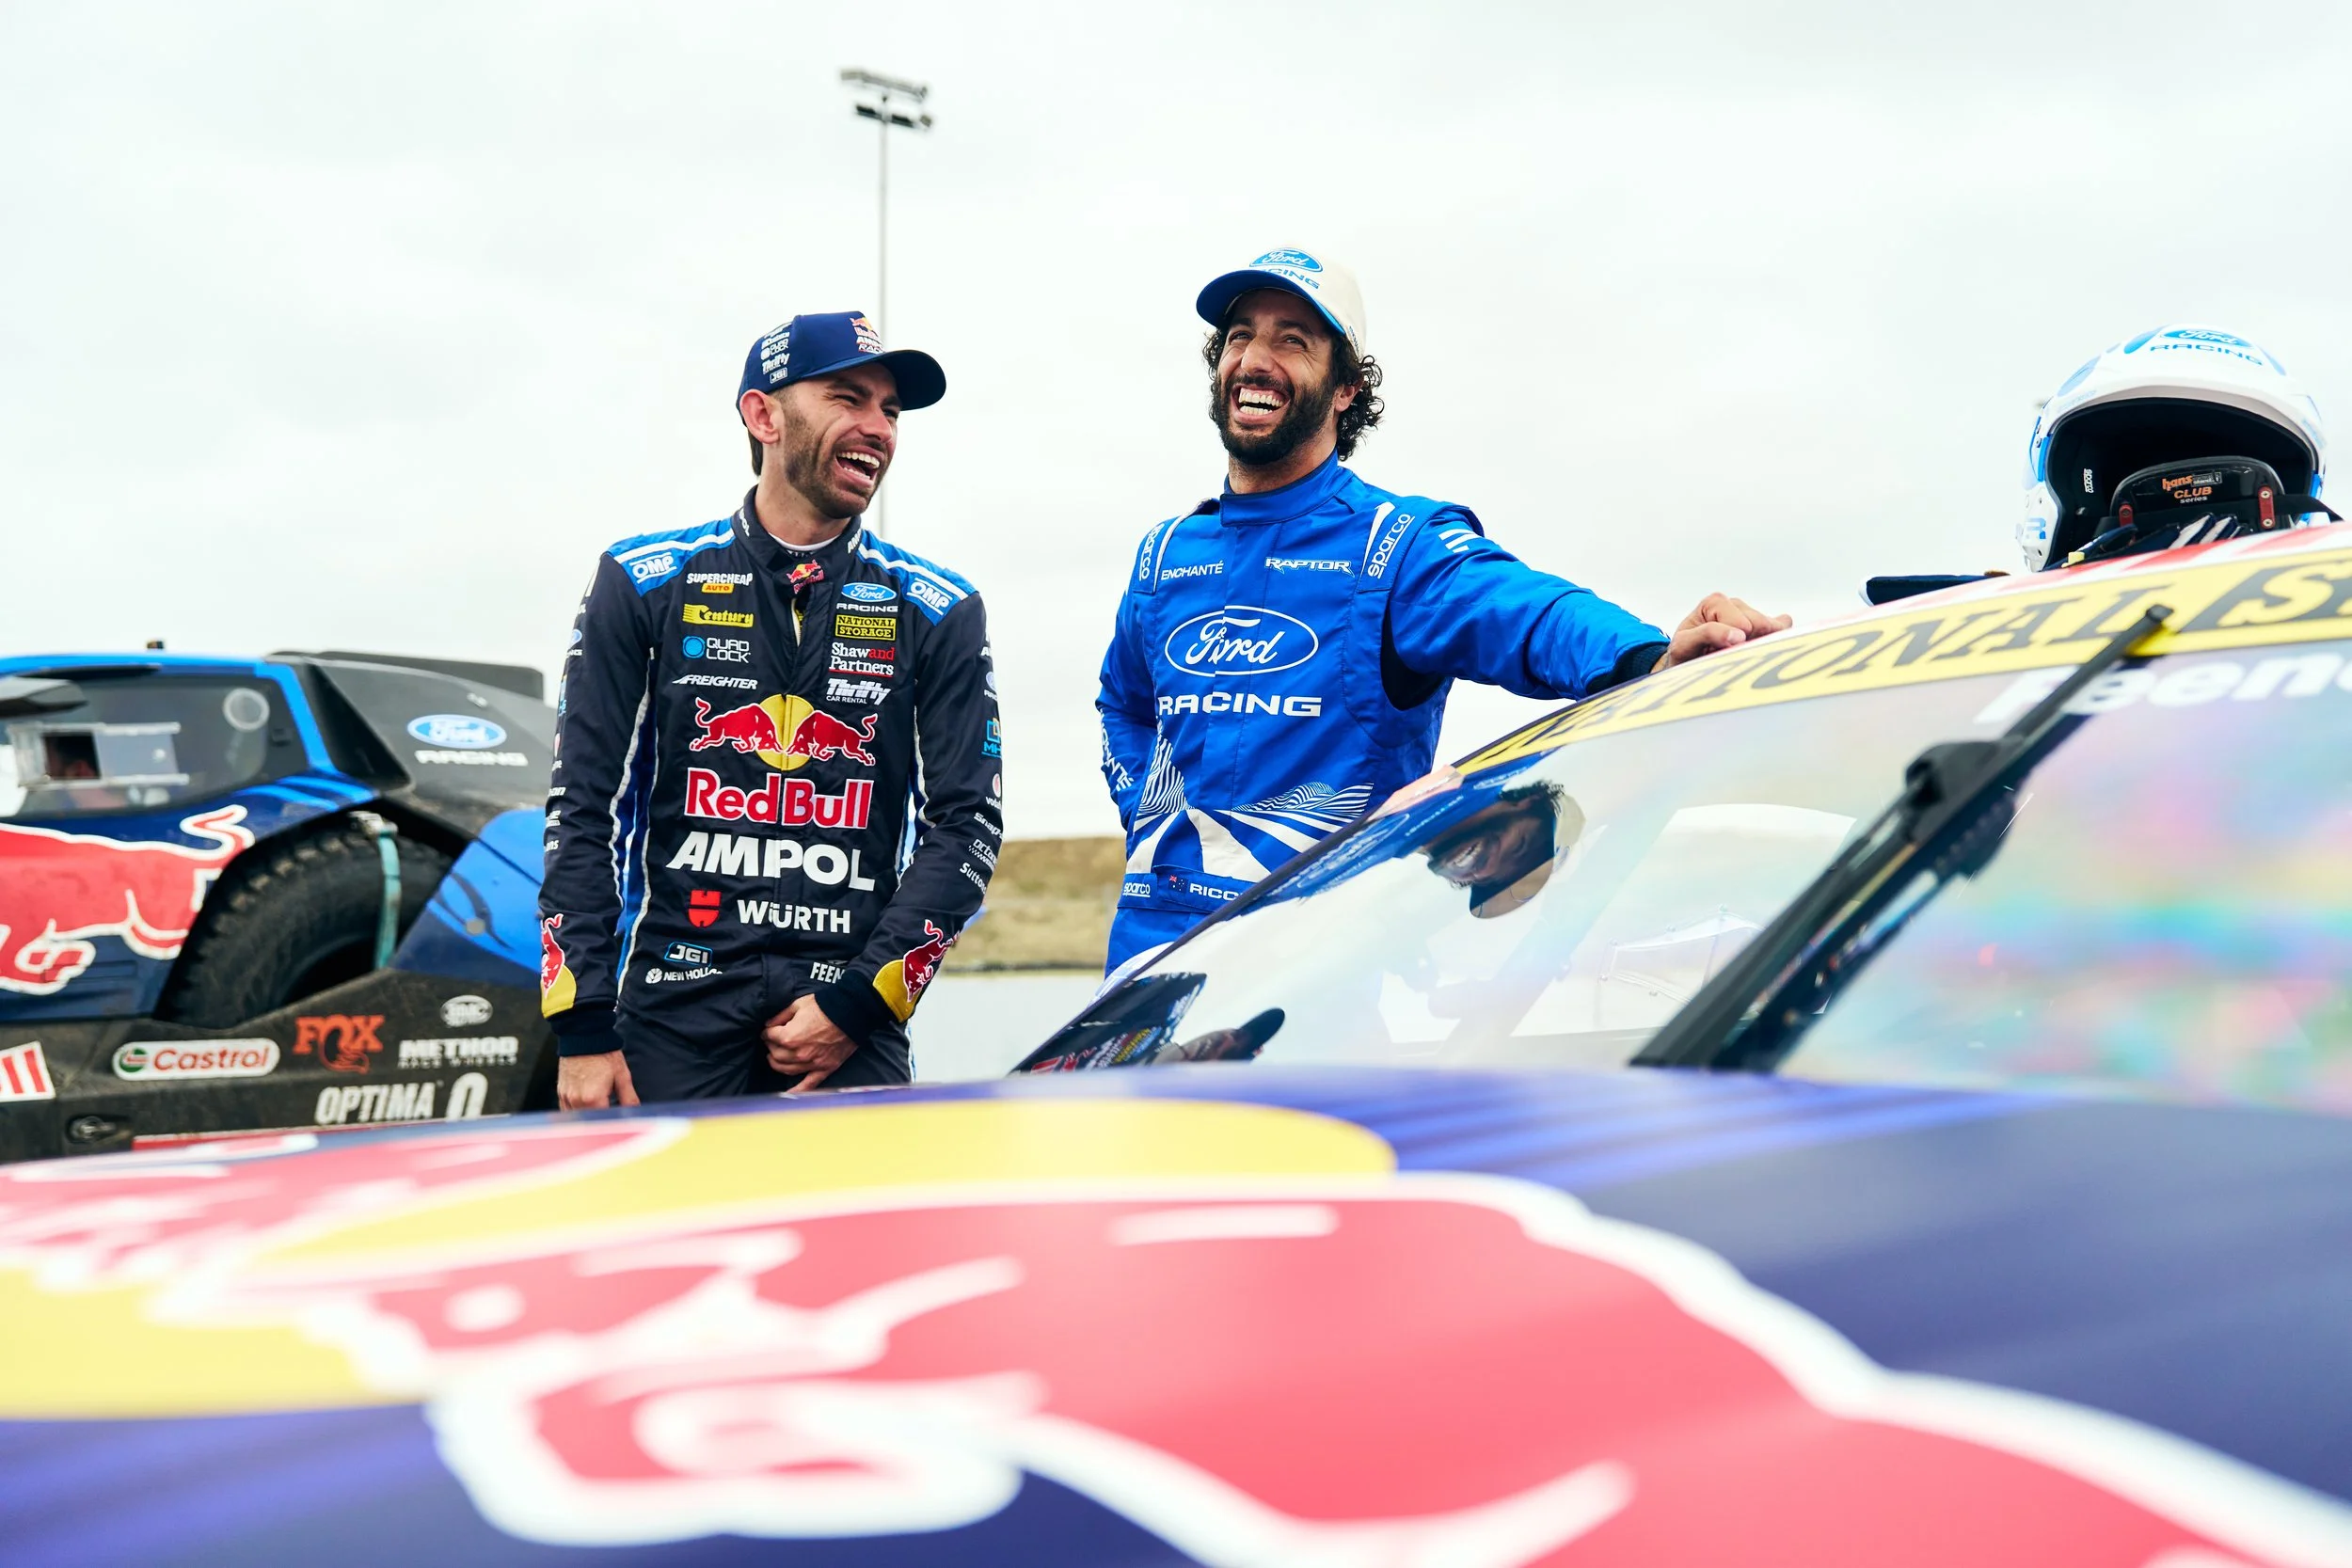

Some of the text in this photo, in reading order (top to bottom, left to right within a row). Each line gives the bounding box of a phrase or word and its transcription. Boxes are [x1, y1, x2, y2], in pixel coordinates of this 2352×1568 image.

[1262, 250, 1309, 264] Ford
[2151, 344, 2263, 365] RACING
[2174, 486, 2213, 499] CLUB
[2180, 496, 2208, 504] series
[1367, 514, 1411, 579] sparco
[632, 556, 674, 579] OMP
[1161, 561, 1224, 580] ENCHANTÉ
[1265, 557, 1355, 578] RAPTOR
[686, 572, 753, 586] SUPERCHEAP
[850, 583, 885, 599] Ford
[911, 581, 949, 609] OMP
[694, 604, 754, 627] Century
[836, 603, 898, 612] RACING
[838, 616, 894, 627] NATIONAL
[839, 626, 892, 638] STORAGE
[1185, 616, 1285, 665] Ford
[707, 638, 750, 652] QUAD
[707, 649, 751, 663] LOCK
[829, 656, 894, 675] Partners
[673, 674, 758, 689] FREIGHTER
[1974, 653, 2352, 723] Feen
[827, 678, 891, 705] Thrifty
[842, 696, 867, 705] RENTAL
[1158, 691, 1322, 717] RACING
[666, 831, 876, 892] AMPOL
[1123, 882, 1151, 895] sparco
[1189, 883, 1242, 900] RICC
[737, 899, 850, 934] WÜRTH
[669, 944, 708, 964] JGI
[663, 972, 685, 981] NEW
[293, 1014, 385, 1069] FOX
[399, 1036, 519, 1058] METHOD
[153, 1047, 269, 1071] Castrol
[314, 1085, 437, 1126] OPTIMA
